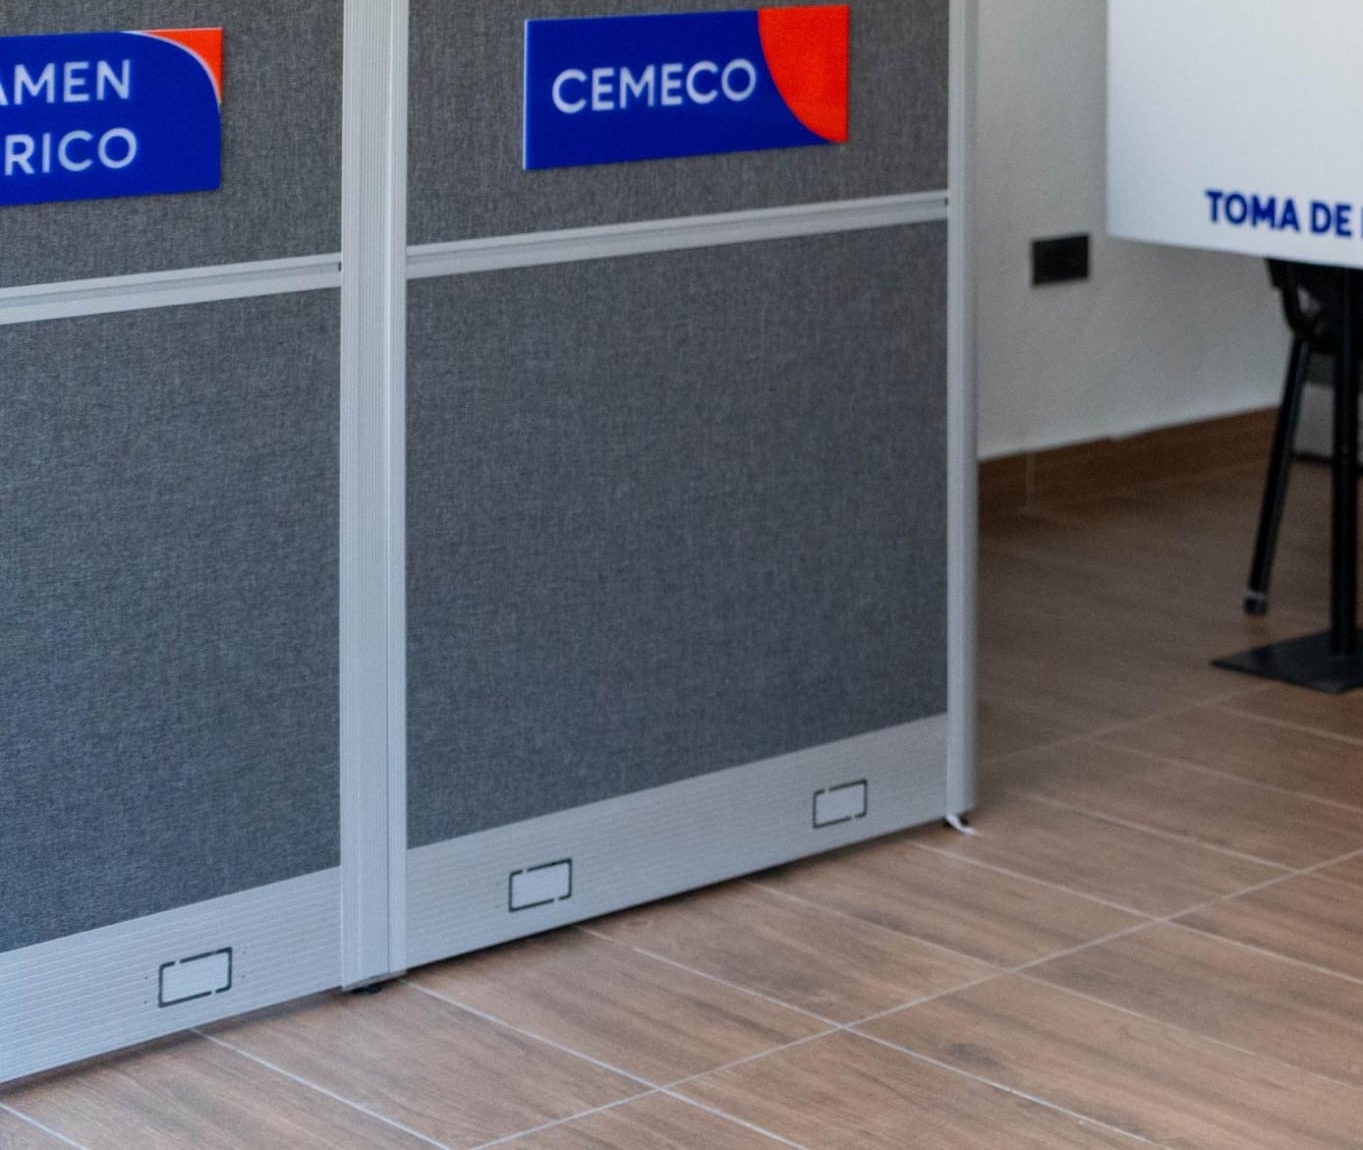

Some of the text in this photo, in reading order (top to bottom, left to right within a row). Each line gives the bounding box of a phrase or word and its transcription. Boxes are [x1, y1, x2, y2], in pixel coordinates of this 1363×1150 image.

[0, 58, 131, 106] MEN
[552, 58, 757, 114] CEMECO
[1204, 189, 1300, 233] TOMA
[1310, 200, 1353, 238] DE
